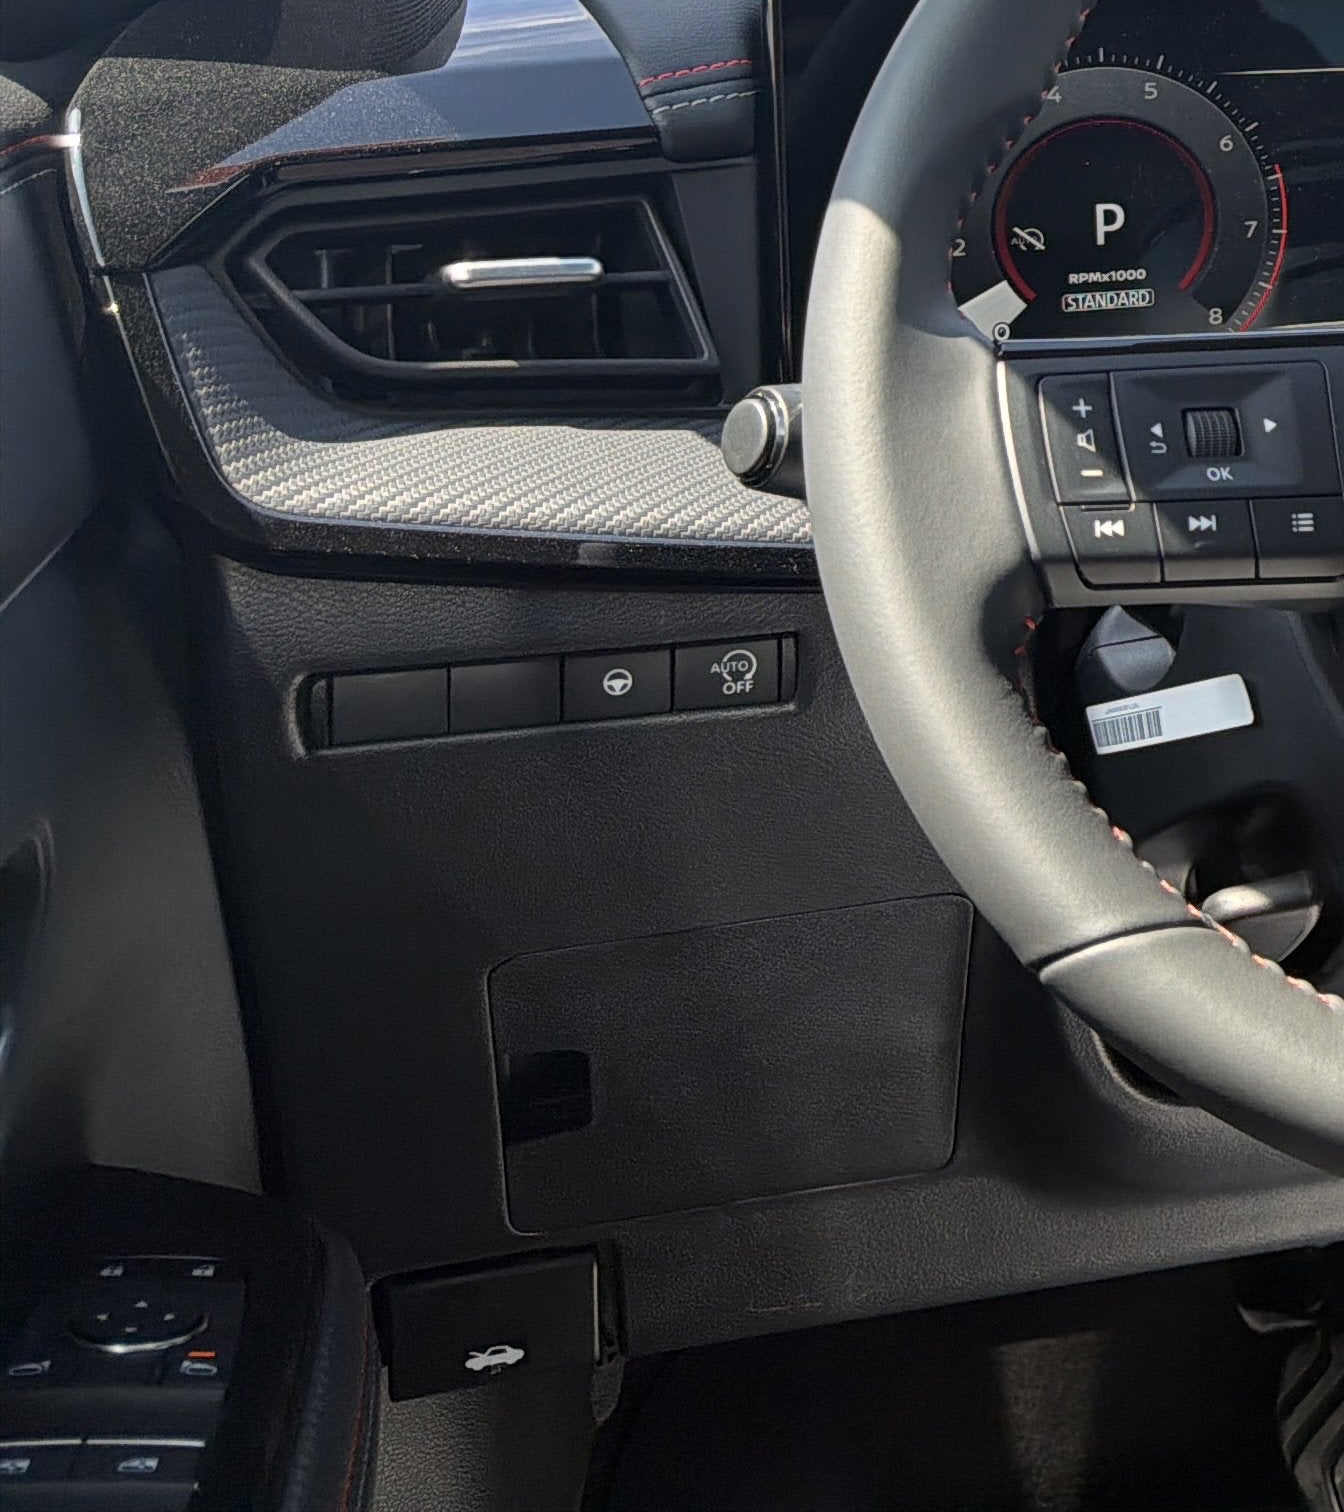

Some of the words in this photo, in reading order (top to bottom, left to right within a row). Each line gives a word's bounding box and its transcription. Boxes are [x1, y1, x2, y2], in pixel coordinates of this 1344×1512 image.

[1046, 85, 1063, 104] 4
[1144, 82, 1158, 99] 5
[1219, 134, 1234, 152] 6
[1094, 202, 1126, 246] P
[1244, 221, 1258, 238] 7
[951, 238, 967, 257] 2
[1068, 268, 1147, 285] RPMx1000
[1067, 289, 1150, 311] STANDARD
[1207, 307, 1224, 326] 8
[993, 322, 1010, 341] 0
[1206, 466, 1234, 482] OK
[710, 660, 749, 674] AUTO
[722, 680, 754, 695] OFF
